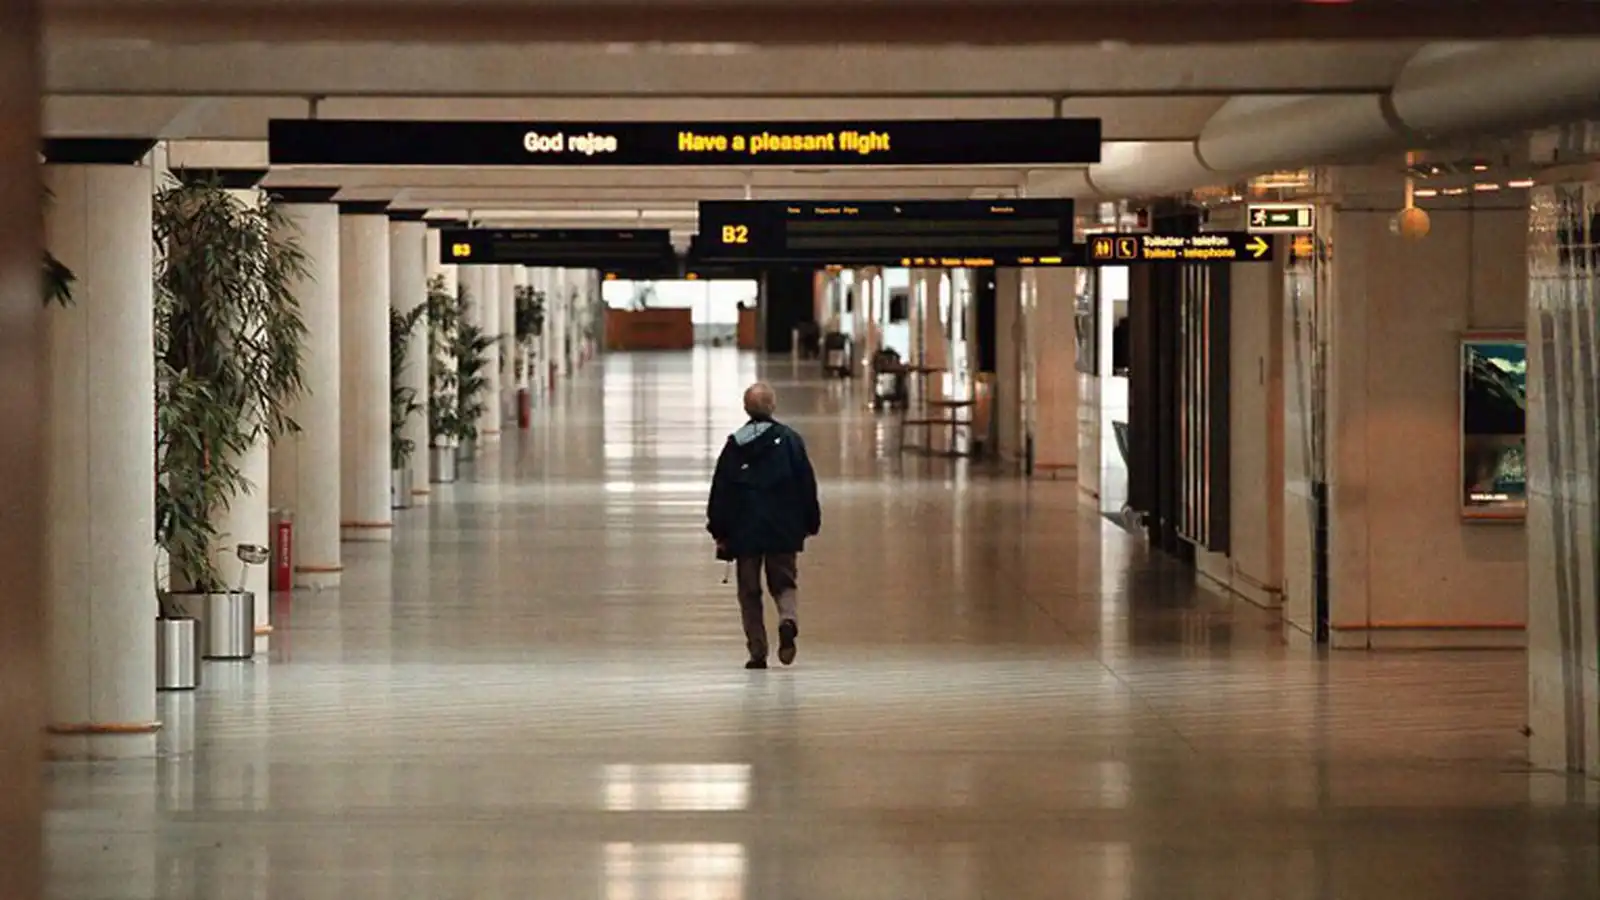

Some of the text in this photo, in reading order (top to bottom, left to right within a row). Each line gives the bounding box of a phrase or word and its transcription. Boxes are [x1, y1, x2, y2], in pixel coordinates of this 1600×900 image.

[523, 131, 618, 156] God rejse
[678, 131, 890, 154] Have a pleasant flight
[722, 225, 748, 243] B2
[1143, 235, 1184, 247] Toiletter
[1192, 235, 1229, 246] telefon
[452, 243, 471, 257] B3
[1143, 247, 1176, 258] Toilets
[1183, 247, 1236, 259] telephone
